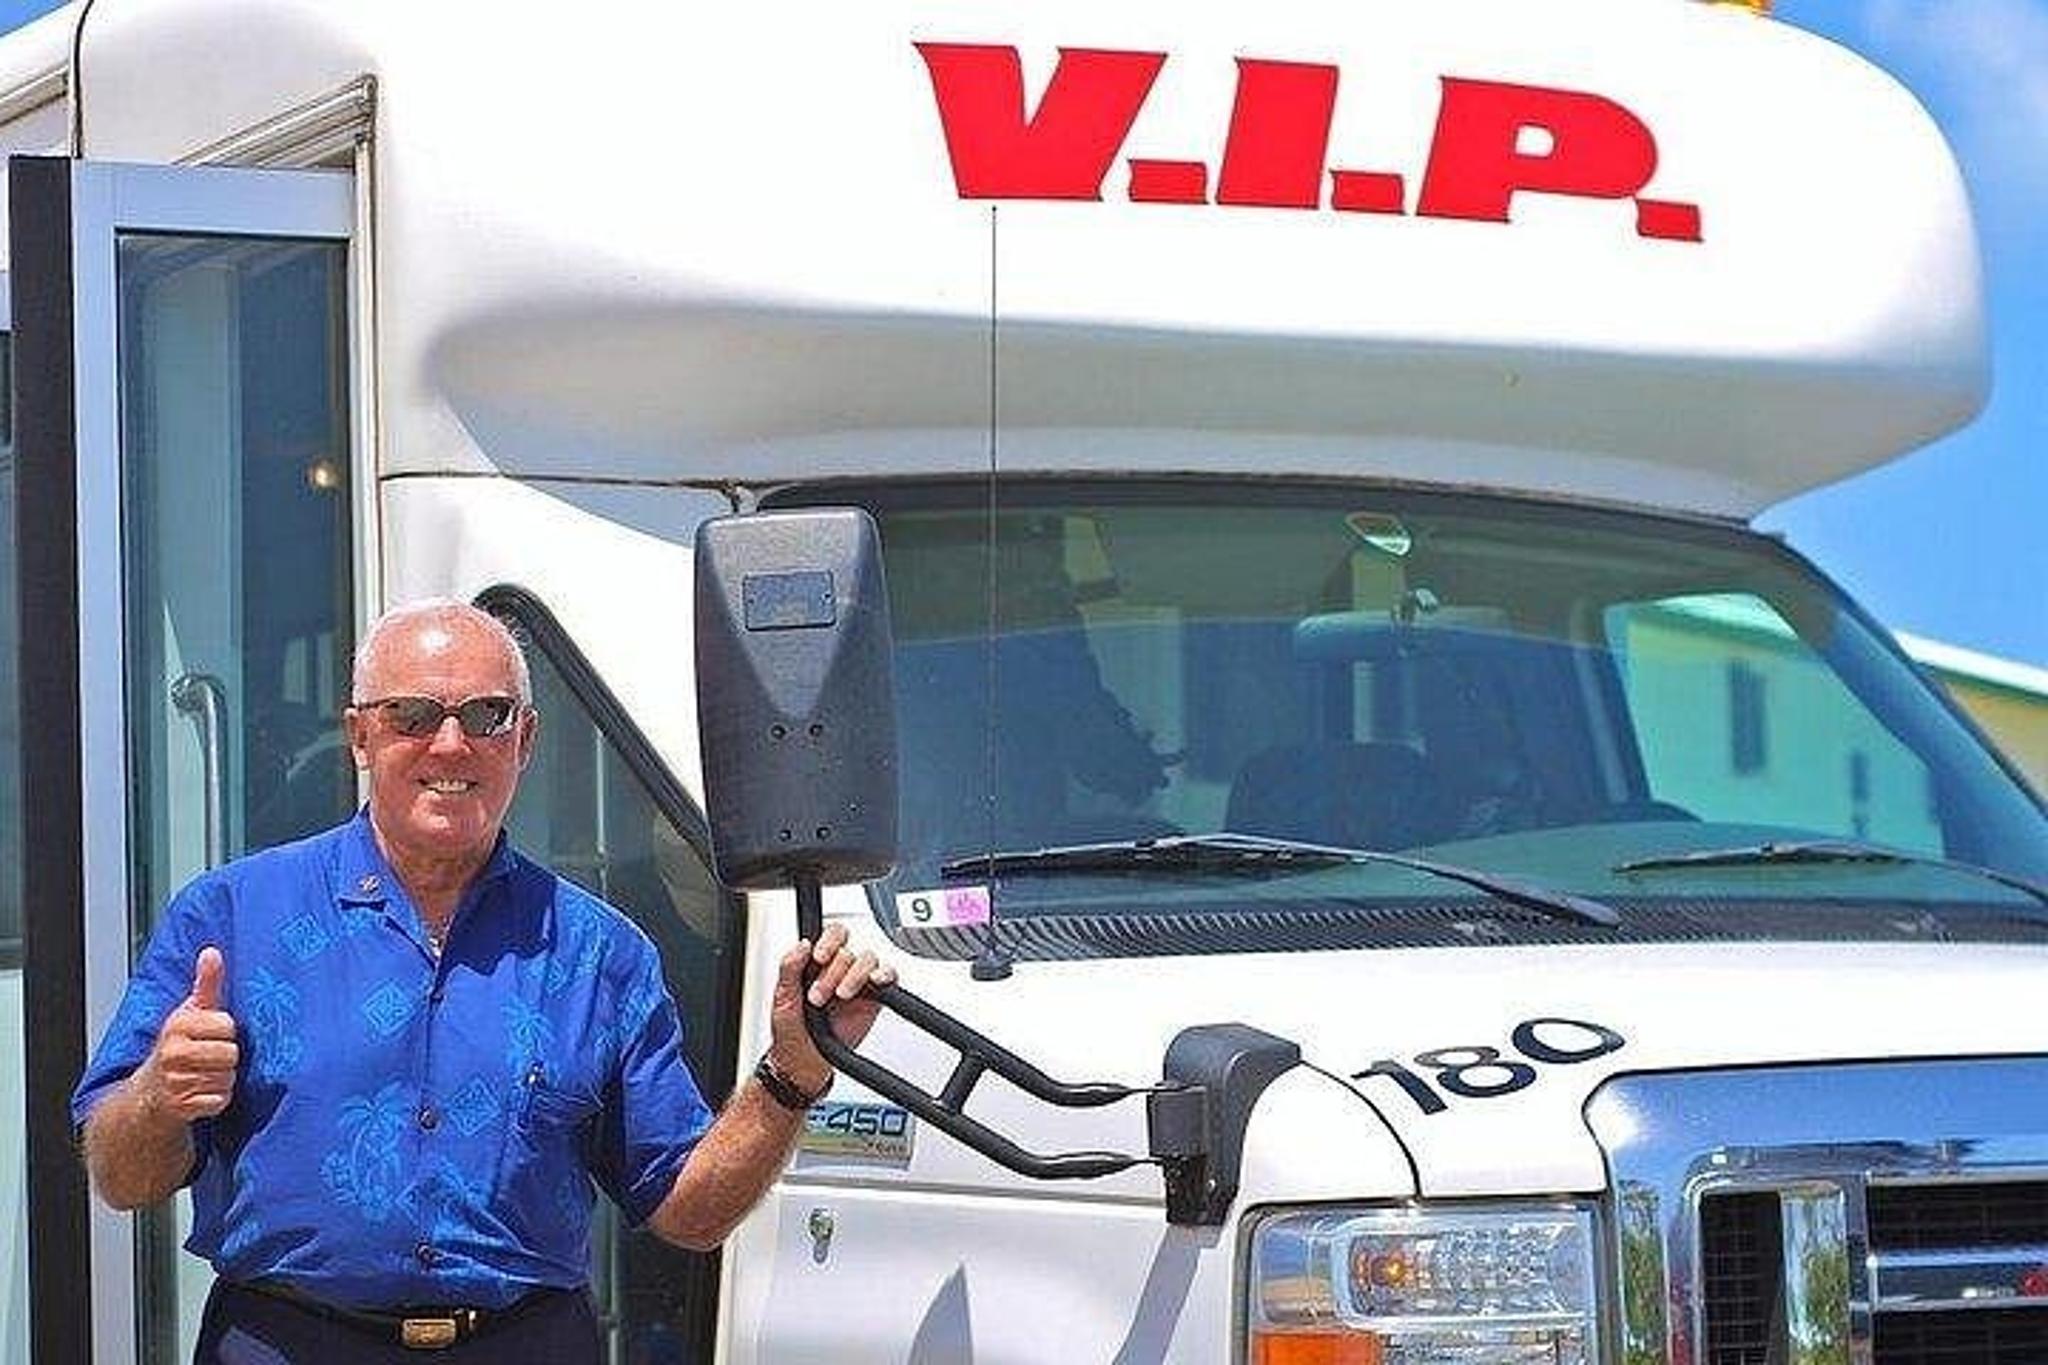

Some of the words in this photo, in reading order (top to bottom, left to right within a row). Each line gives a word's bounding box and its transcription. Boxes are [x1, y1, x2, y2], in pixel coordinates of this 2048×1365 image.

[912, 42, 1703, 242] V.I.P.
[911, 898, 933, 922] 9
[1349, 1017, 1626, 1115] 180
